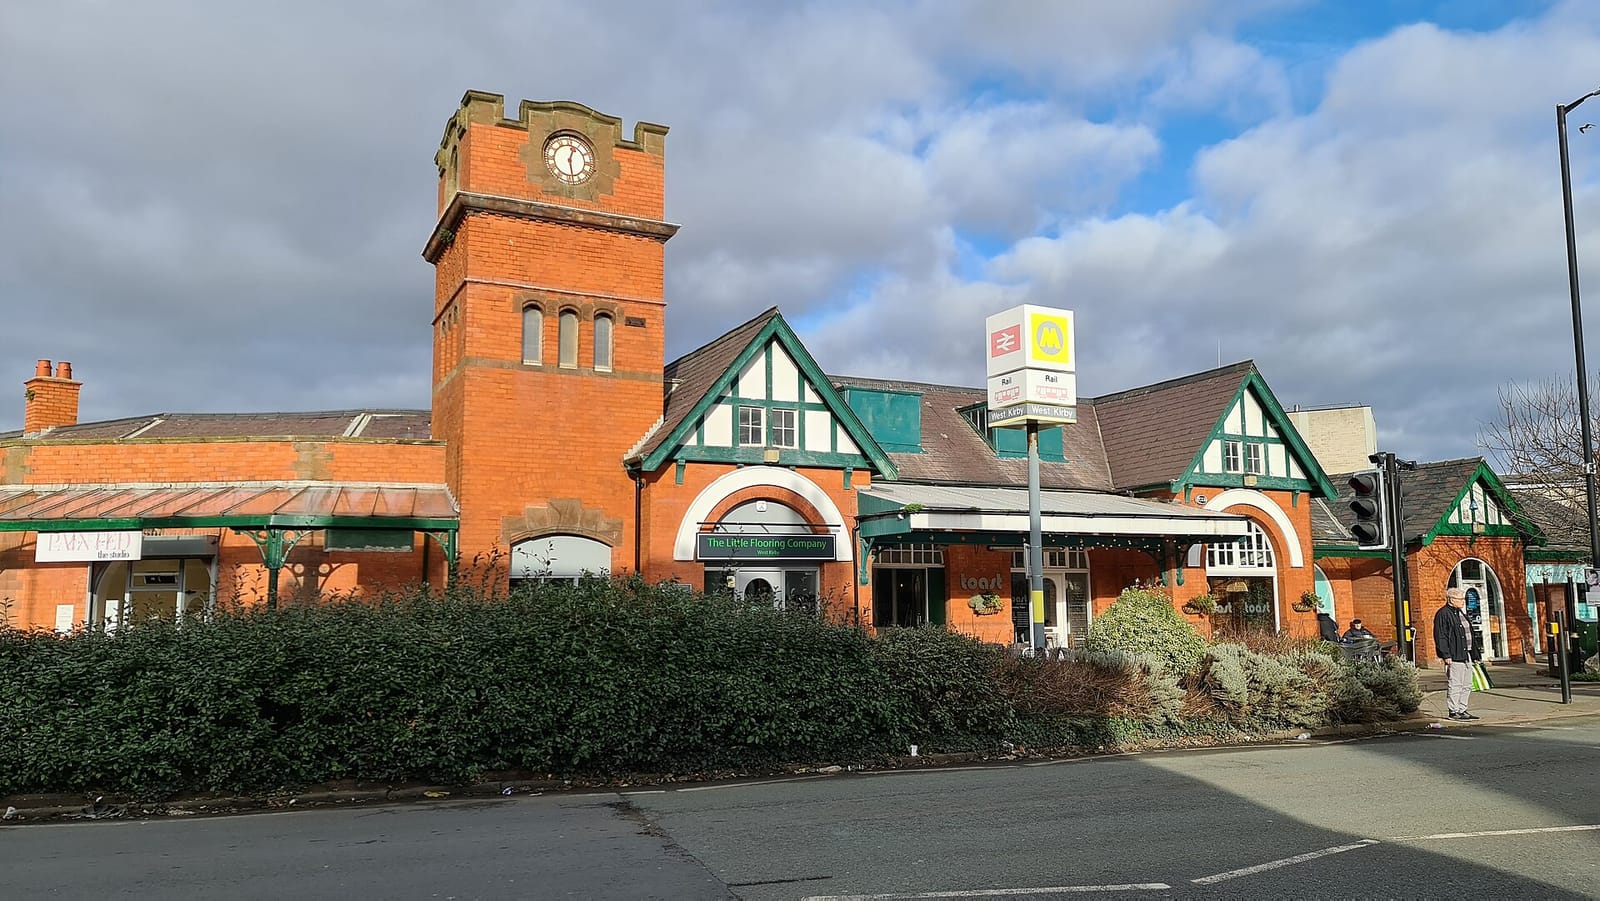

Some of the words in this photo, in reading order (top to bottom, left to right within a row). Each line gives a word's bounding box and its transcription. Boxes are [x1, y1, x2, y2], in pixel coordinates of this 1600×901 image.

[1002, 377, 1012, 386] Rail
[1045, 374, 1058, 383] Rail
[991, 409, 1006, 420] West
[1008, 406, 1025, 417] Kirby
[1031, 405, 1050, 416] West
[1053, 407, 1073, 418] Kirby
[707, 538, 725, 548] The
[726, 538, 749, 548] Little
[750, 538, 786, 550] Flooring
[787, 538, 827, 550] Company
[97, 550, 109, 559] the
[109, 549, 130, 559] studio
[960, 573, 1003, 590] toast
[1245, 601, 1271, 613] toast
